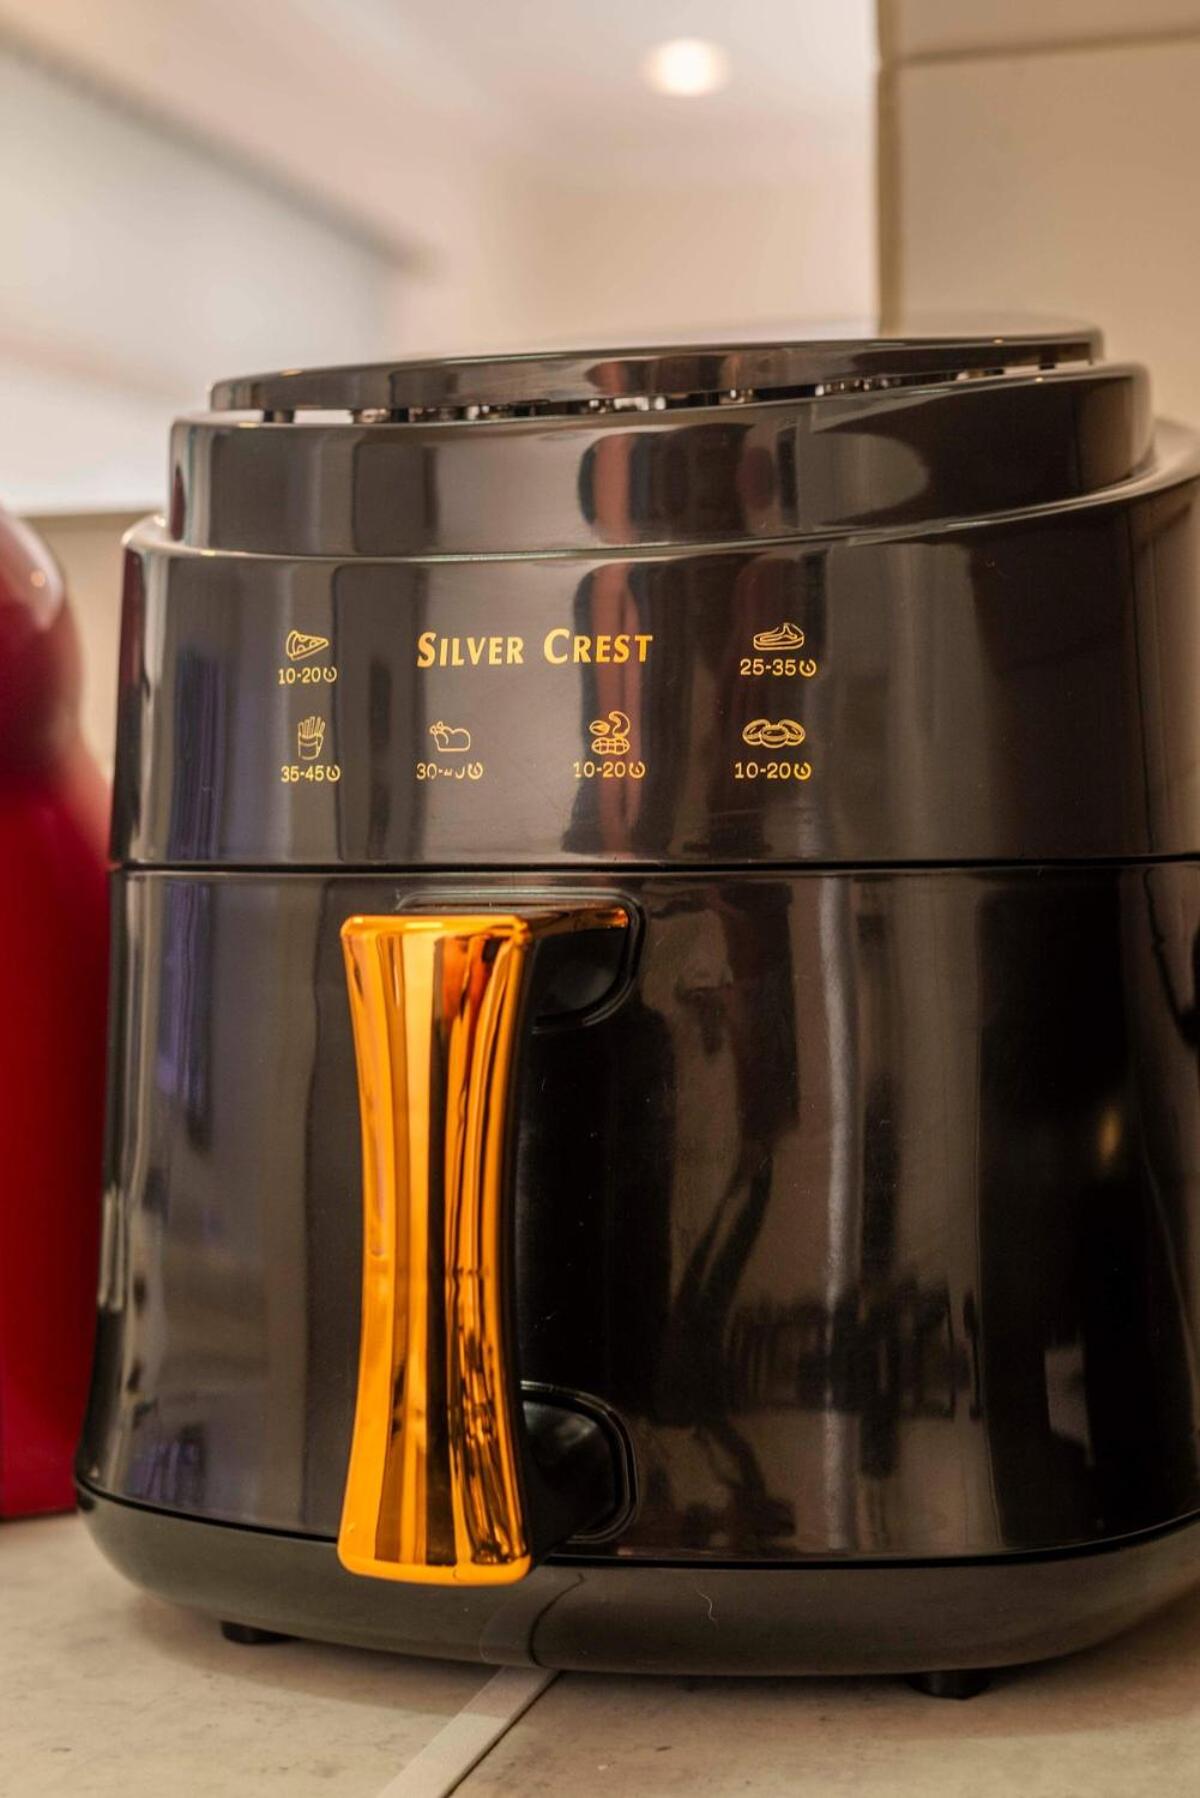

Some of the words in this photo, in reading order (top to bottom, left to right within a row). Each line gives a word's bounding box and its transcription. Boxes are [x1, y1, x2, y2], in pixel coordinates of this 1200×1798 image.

[416, 631, 524, 668] SILVER
[543, 628, 653, 665] CREST
[278, 667, 321, 684] 10-20
[740, 658, 796, 676] 25-35
[281, 765, 325, 783] 35-45
[573, 761, 626, 778] 10-20
[734, 762, 791, 779] 10-20
